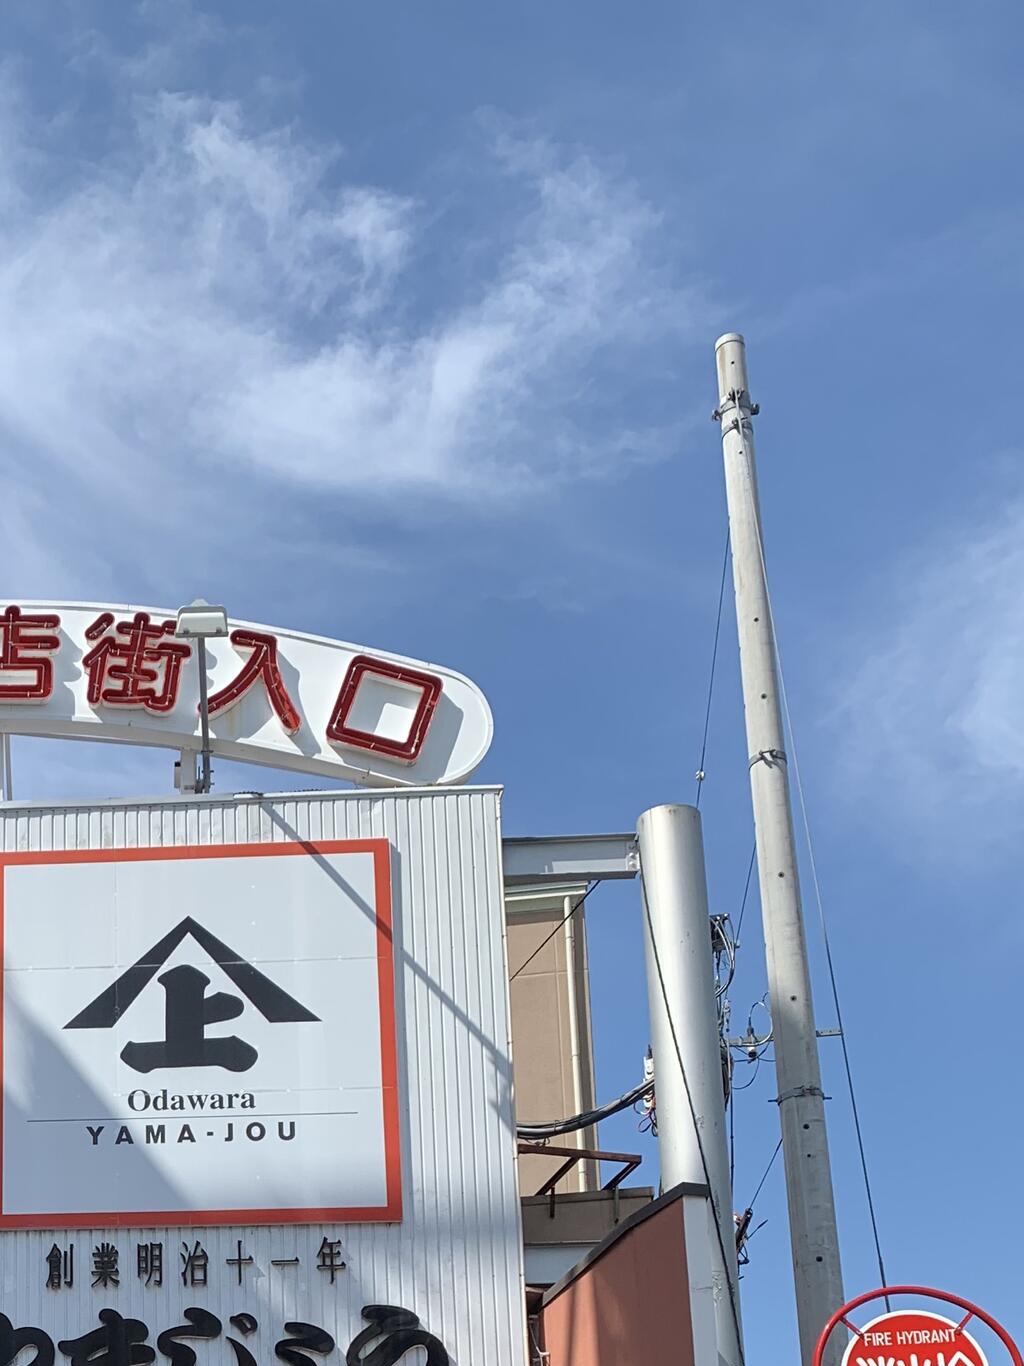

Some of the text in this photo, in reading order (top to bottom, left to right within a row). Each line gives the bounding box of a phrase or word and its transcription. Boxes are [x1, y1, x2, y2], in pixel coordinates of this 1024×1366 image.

[126, 1088, 257, 1113] Odawara
[85, 1120, 299, 1147] YAMA-JOU
[45, 1237, 347, 1290] 創業明治十一年
[864, 1328, 956, 1346] FIRE HYDRANT
